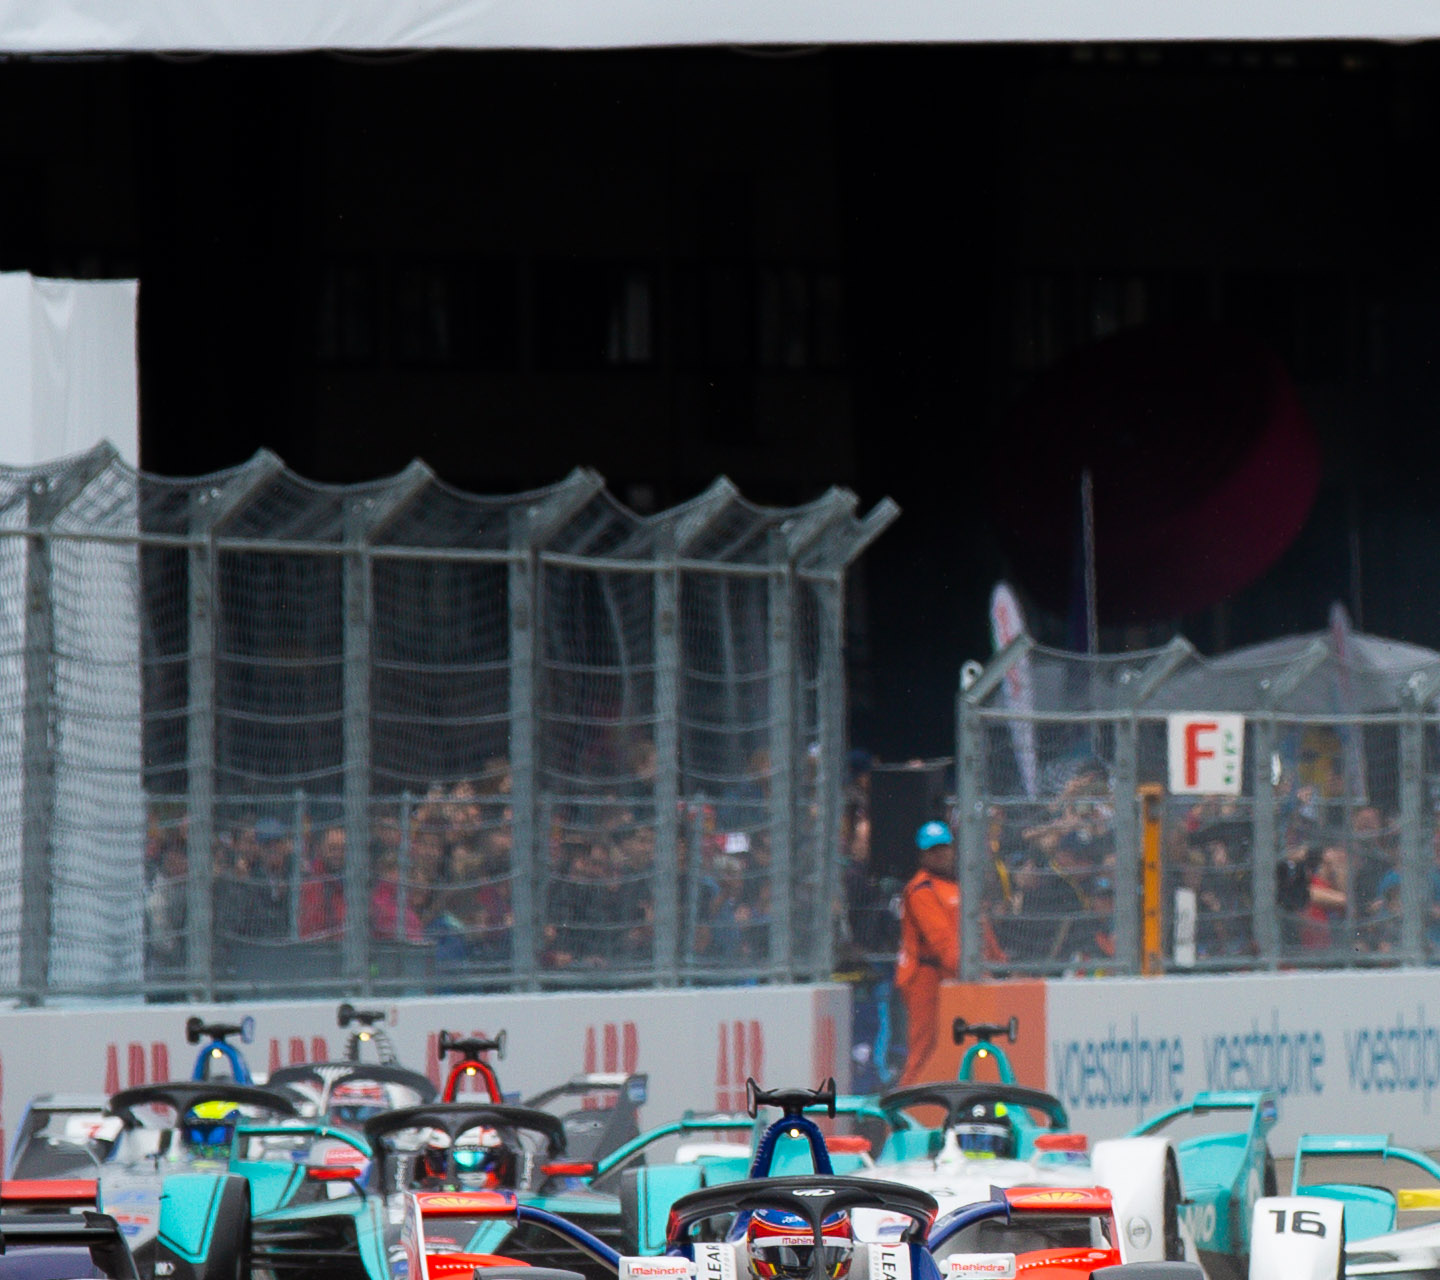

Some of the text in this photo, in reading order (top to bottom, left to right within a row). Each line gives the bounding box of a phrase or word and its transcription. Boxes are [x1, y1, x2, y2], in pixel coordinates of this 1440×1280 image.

[1184, 722, 1219, 788] F
[1053, 1012, 1185, 1122] voestalpine
[1204, 1007, 1325, 1098] voestalpine
[782, 1237, 827, 1246] Mahina
[1268, 1209, 1327, 1238] 16
